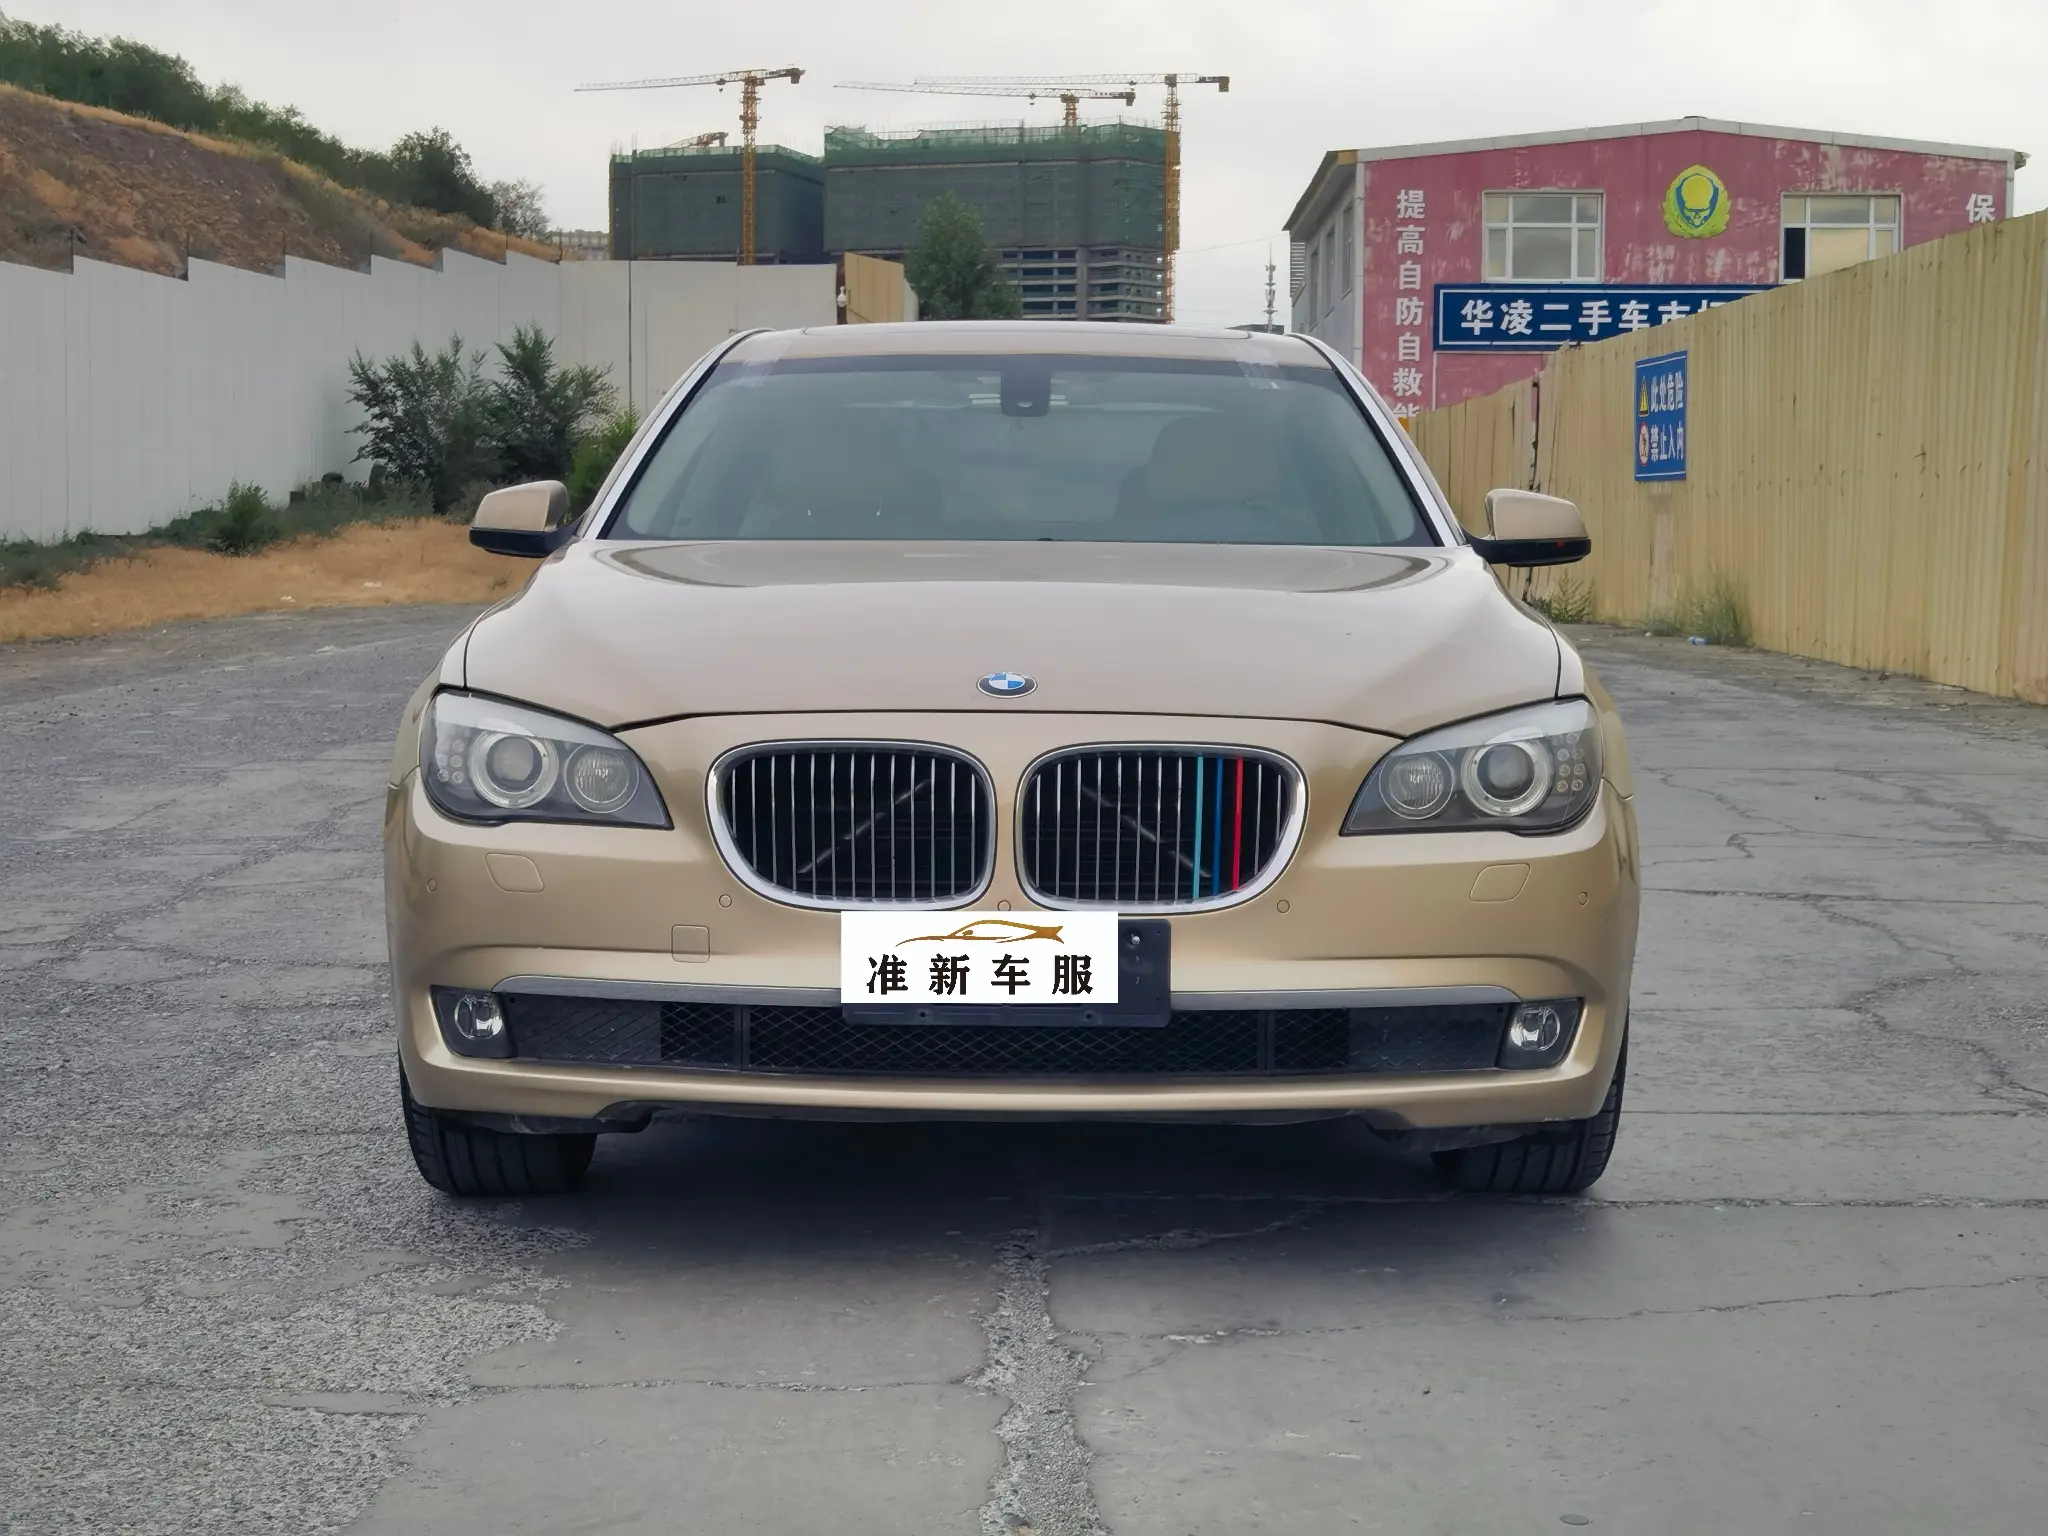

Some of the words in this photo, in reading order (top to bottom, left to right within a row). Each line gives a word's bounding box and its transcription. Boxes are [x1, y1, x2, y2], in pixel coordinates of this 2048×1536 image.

[1965, 193, 1996, 224] 保
[1461, 299, 1726, 335] 华凌二手车市
[1650, 370, 1684, 412] 此处危险
[1650, 420, 1684, 462] 禁止入内
